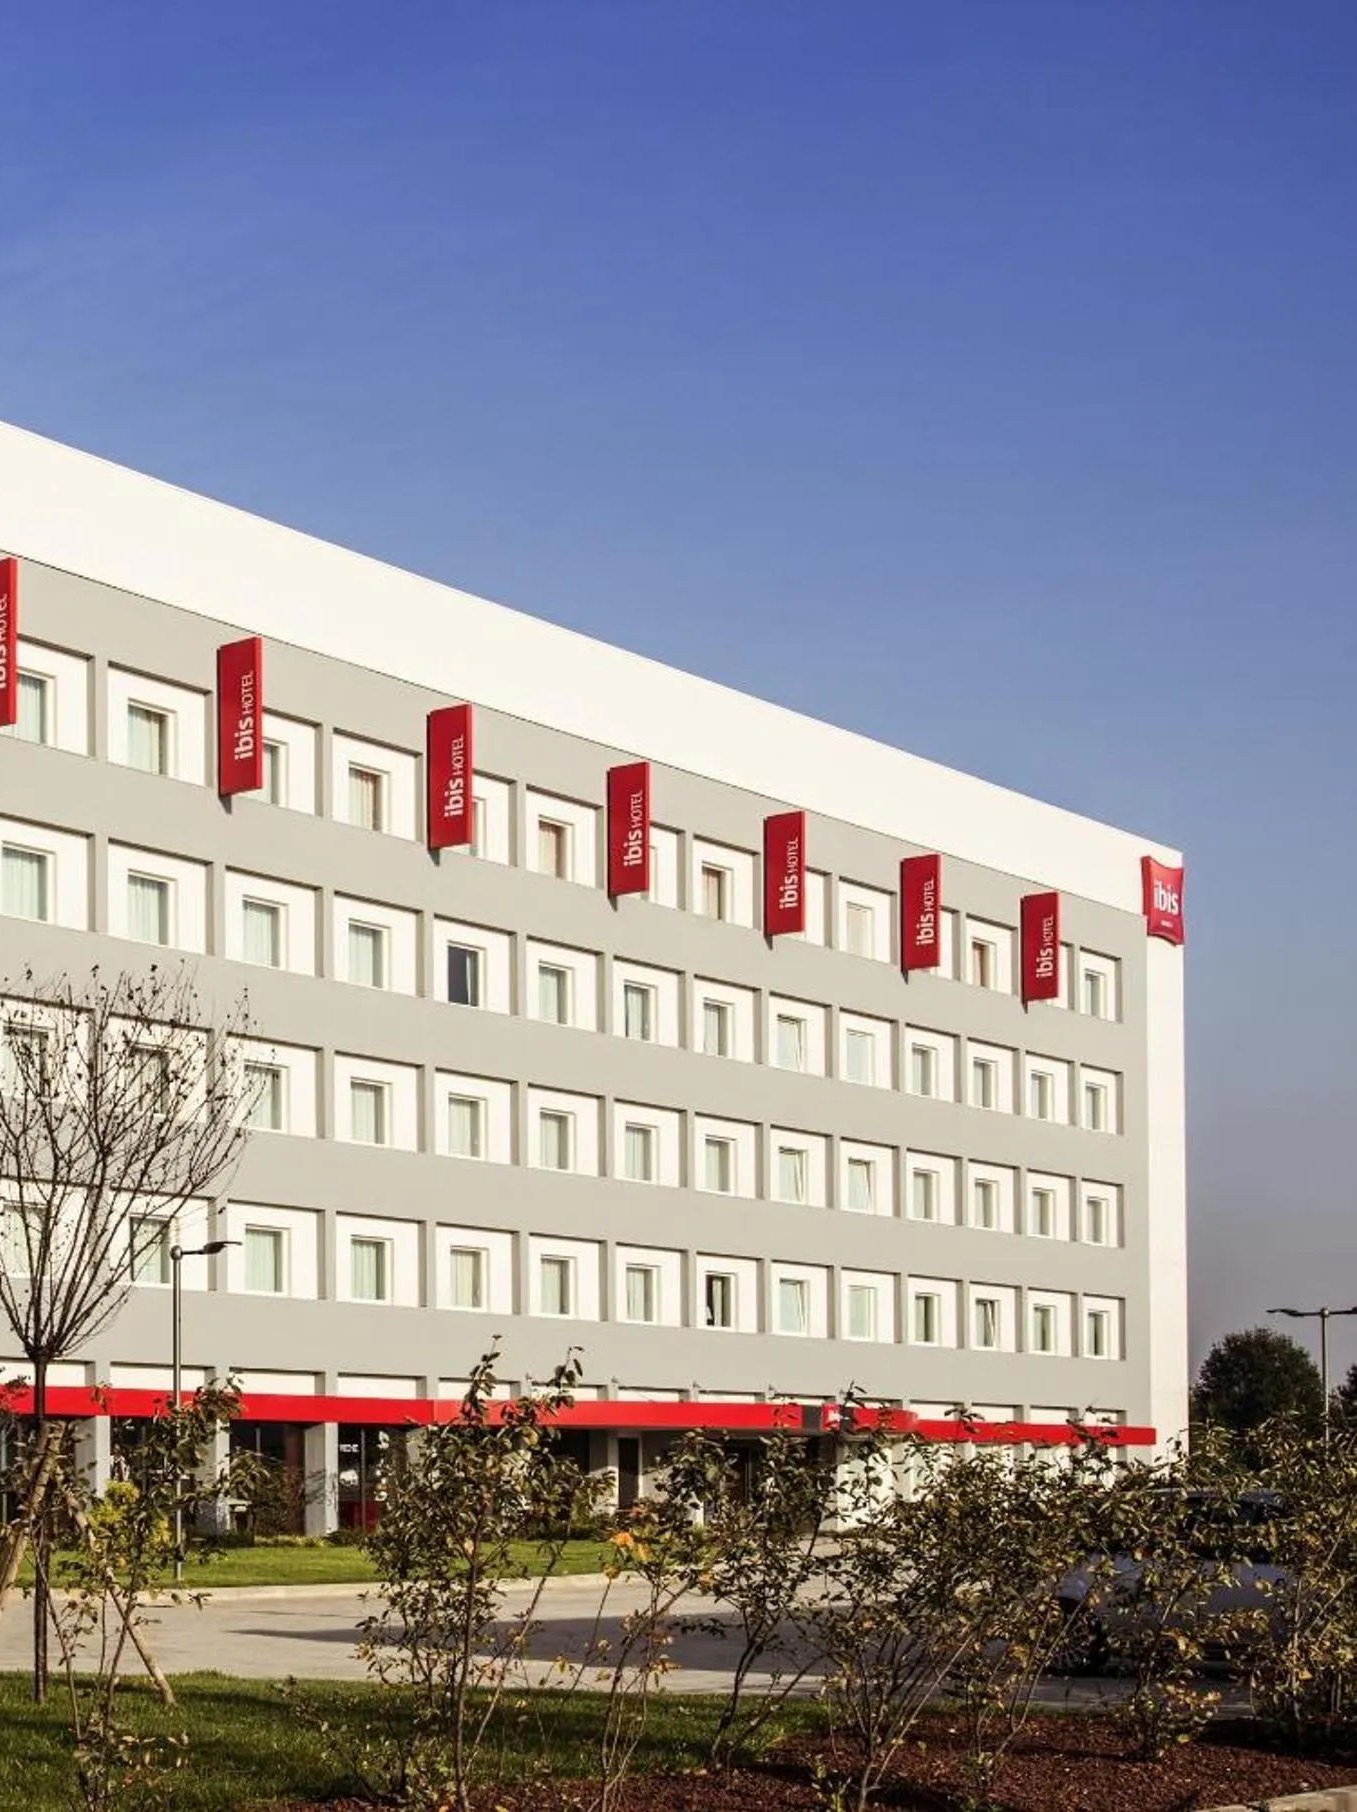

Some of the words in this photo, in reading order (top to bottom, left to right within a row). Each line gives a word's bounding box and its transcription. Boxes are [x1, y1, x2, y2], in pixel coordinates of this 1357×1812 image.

[241, 670, 255, 716] HOTEL
[234, 716, 254, 761] ibis
[451, 733, 465, 776] HOTEL
[444, 777, 464, 818] ibis
[630, 789, 643, 829] HOTEL
[623, 829, 643, 867] ibis
[779, 874, 799, 910] ibis
[1153, 877, 1179, 916] ibis
[915, 913, 935, 946] ibis
[1035, 947, 1054, 979] ibis
